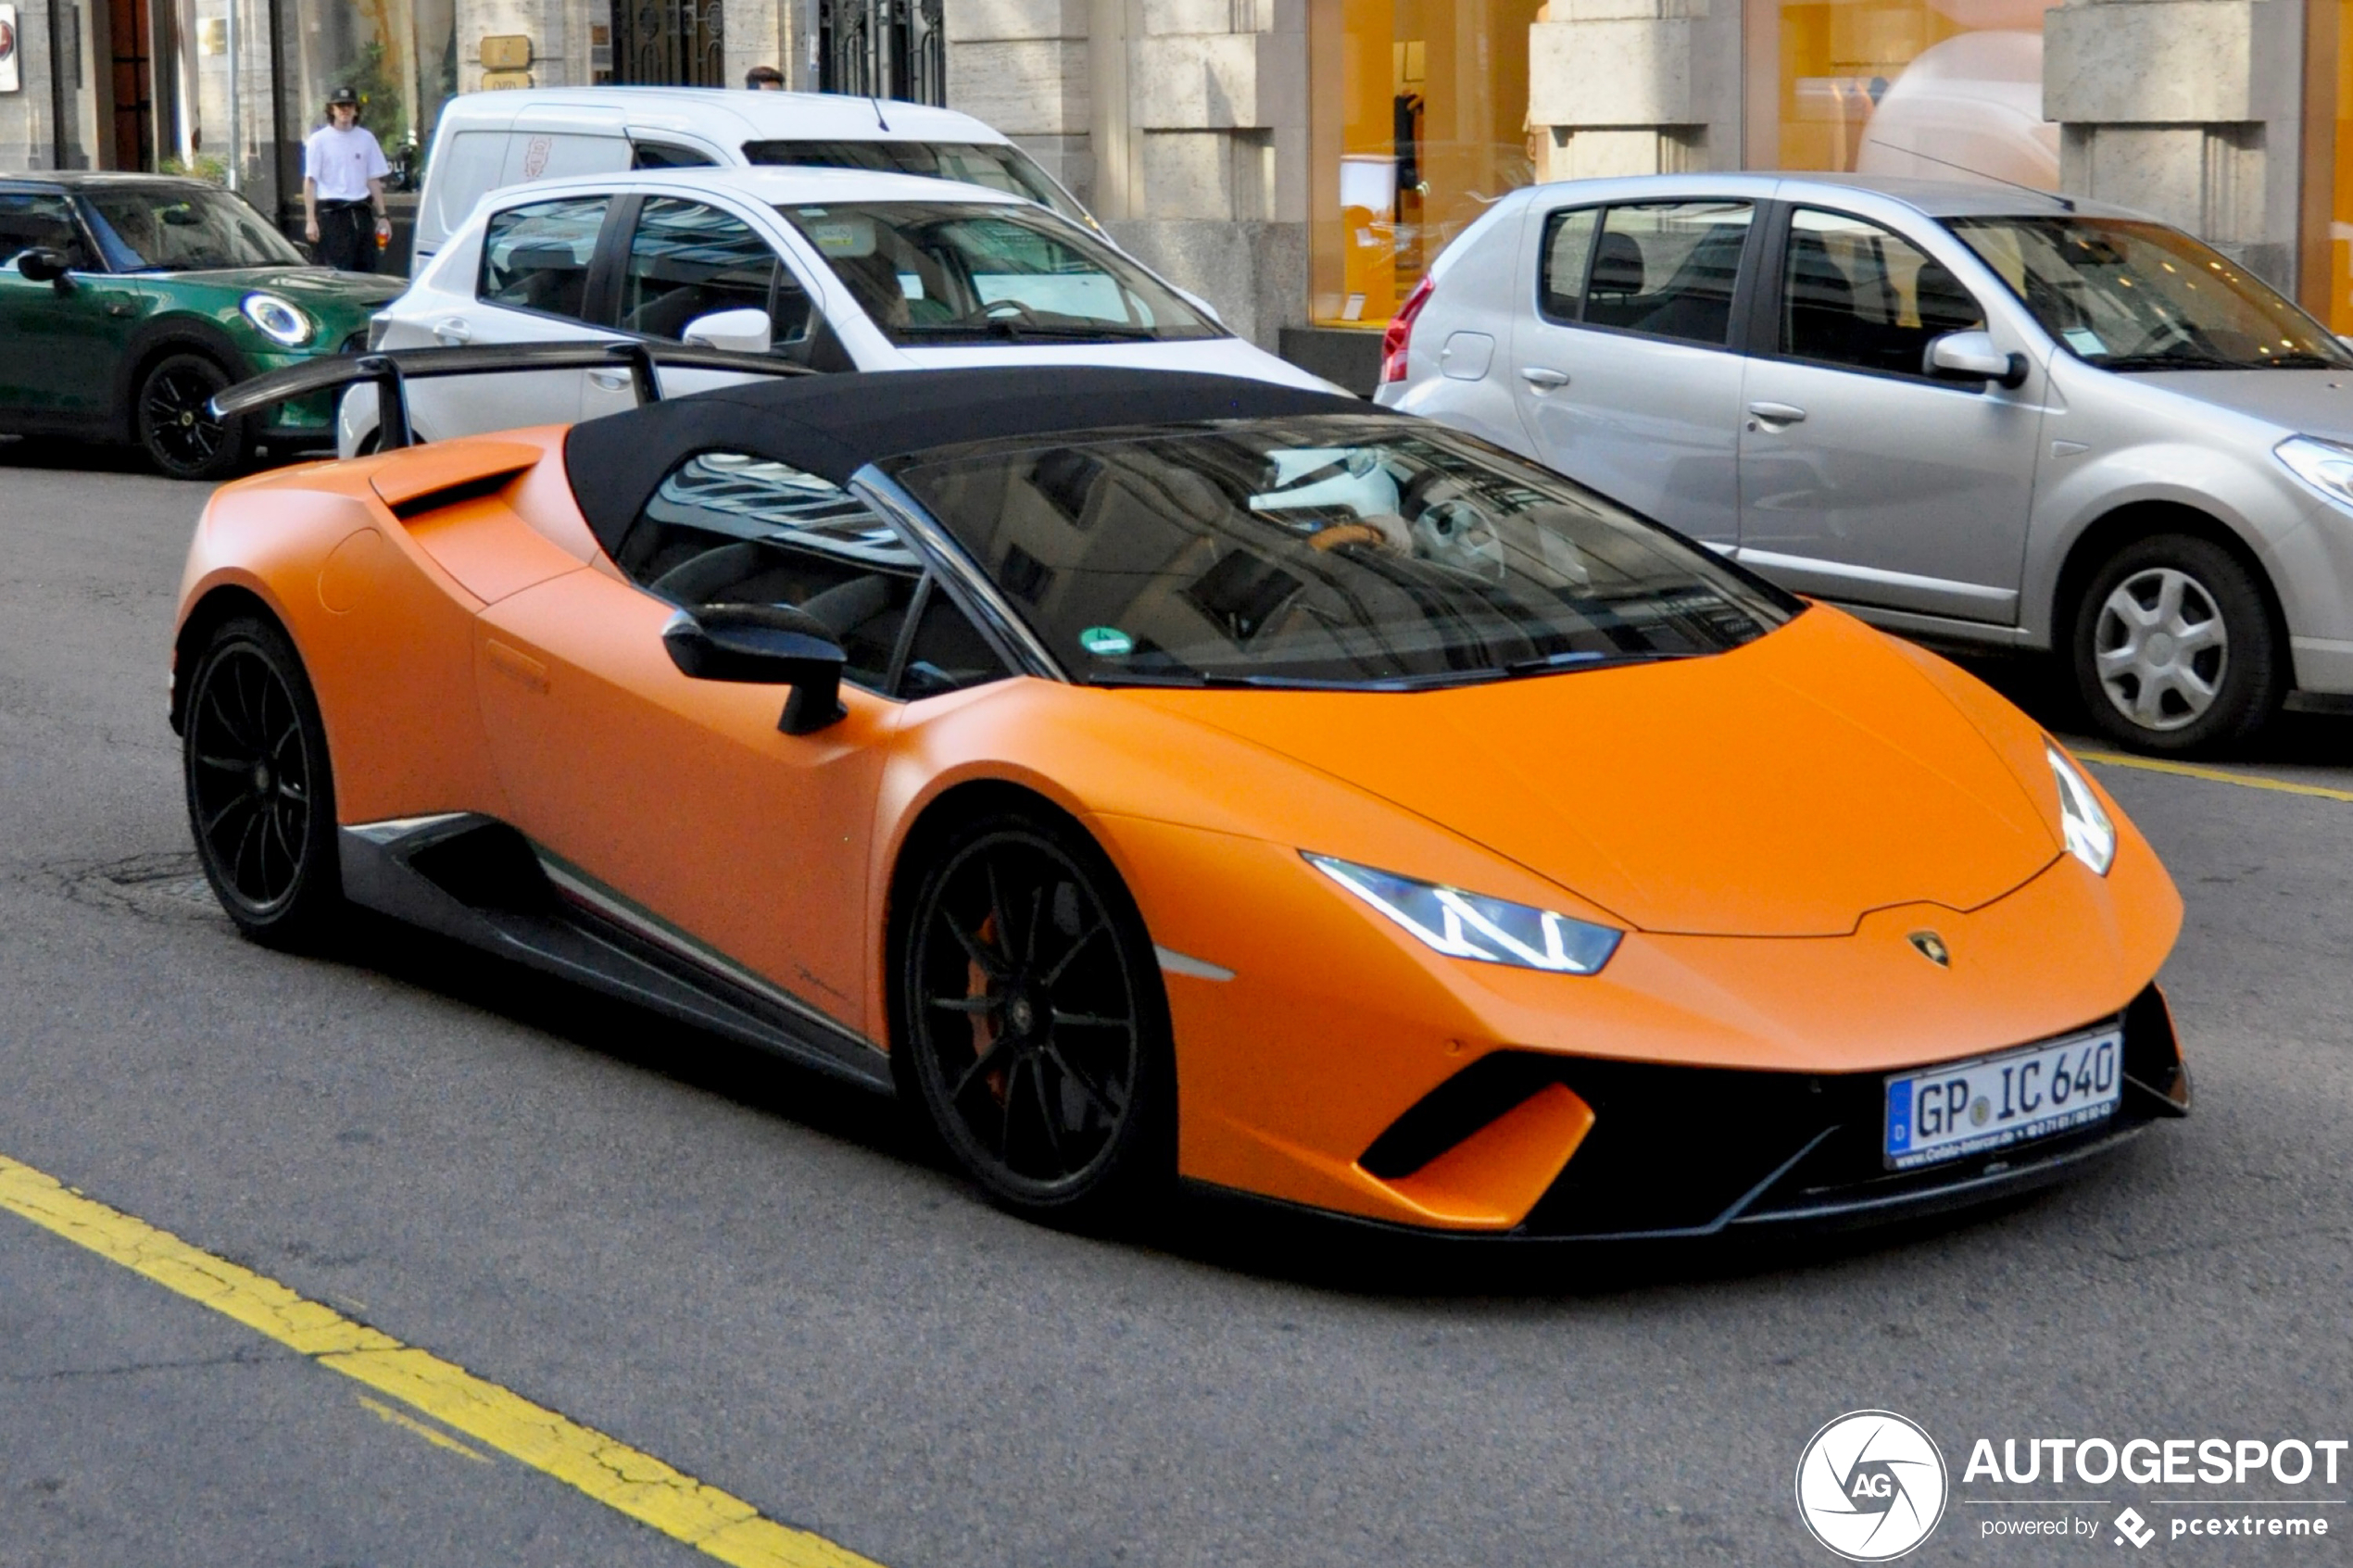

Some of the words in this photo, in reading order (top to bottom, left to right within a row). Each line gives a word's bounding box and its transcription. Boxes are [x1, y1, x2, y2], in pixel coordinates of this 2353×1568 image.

[1918, 1078, 1968, 1137] GP
[1998, 1060, 2041, 1121] IC
[2051, 1040, 2113, 1104] 640
[1894, 1123, 1905, 1142] D
